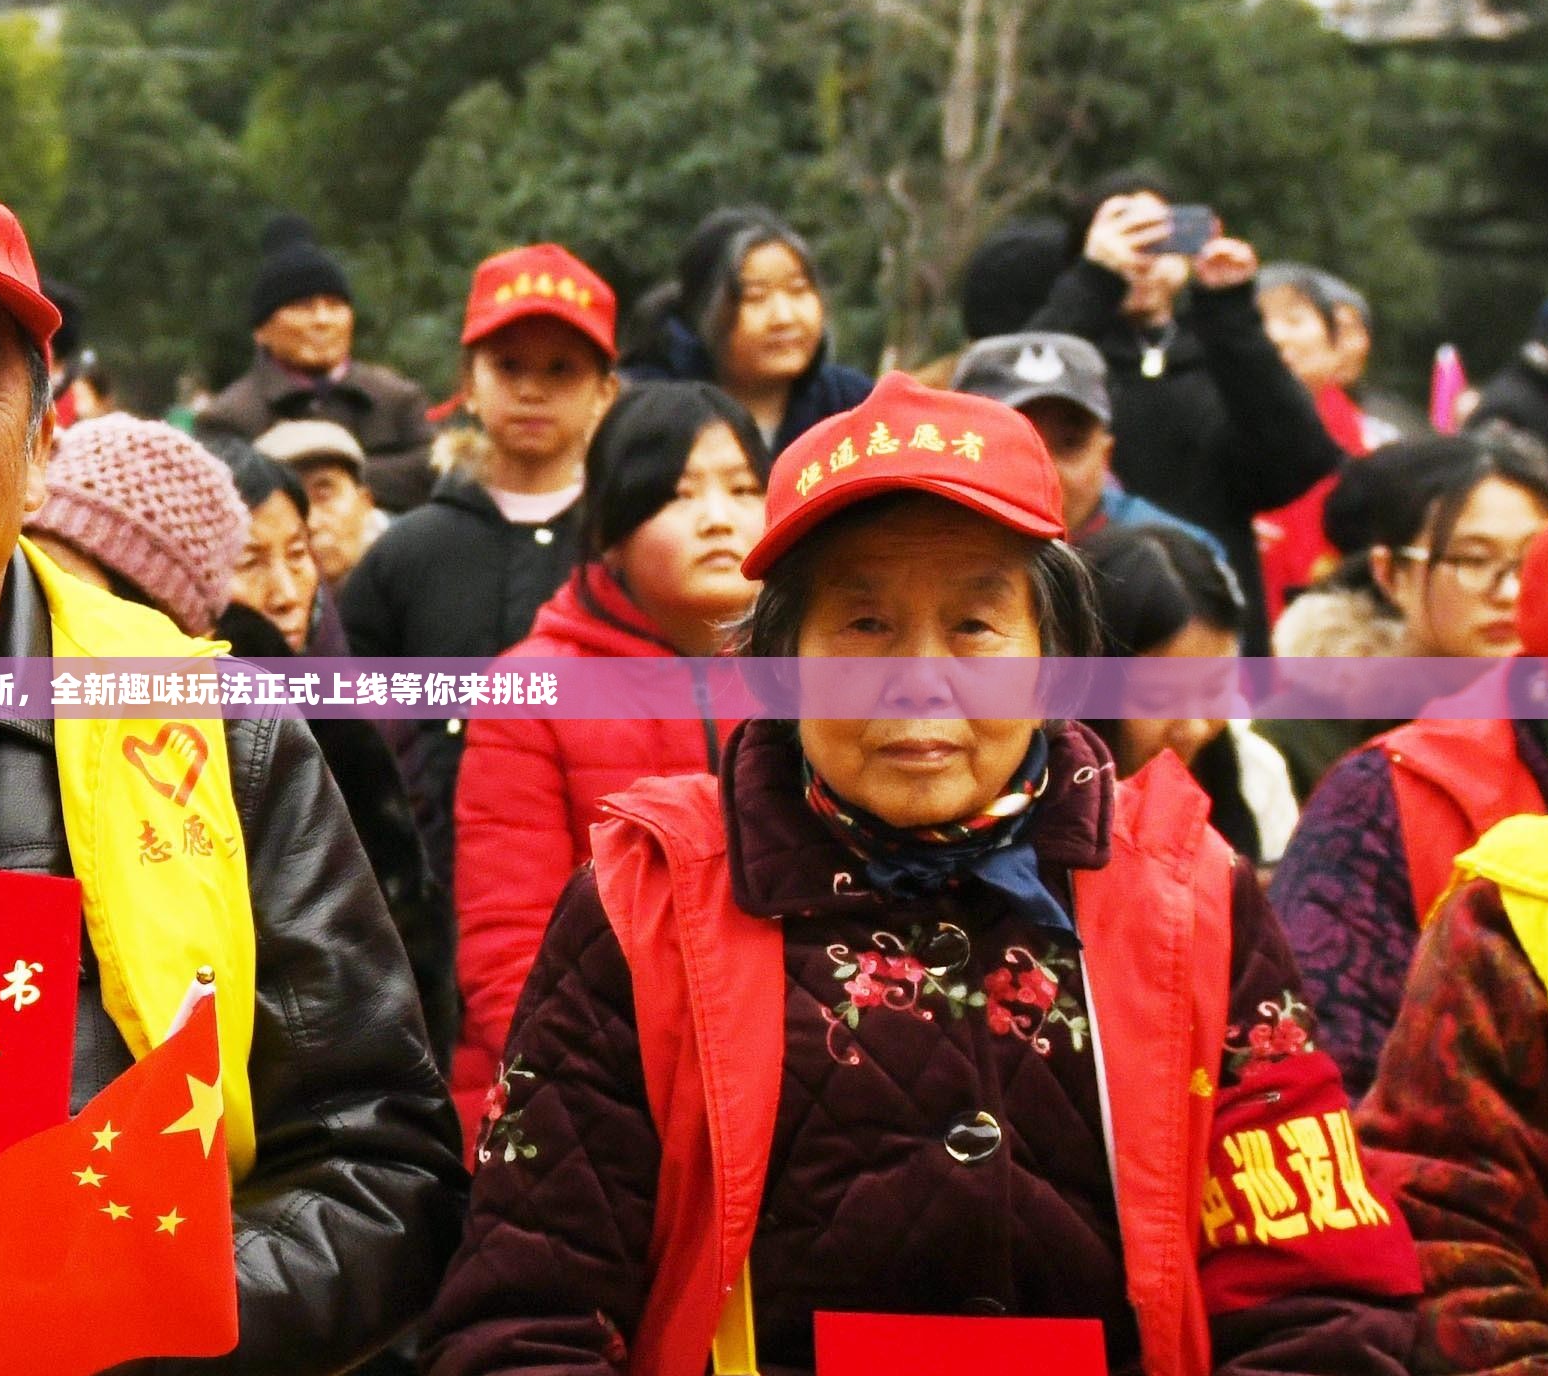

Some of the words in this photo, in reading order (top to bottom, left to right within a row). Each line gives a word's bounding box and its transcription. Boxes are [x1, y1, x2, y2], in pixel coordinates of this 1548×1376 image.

[796, 421, 985, 496] 恒通志愿者
[138, 814, 239, 866] 志愿
